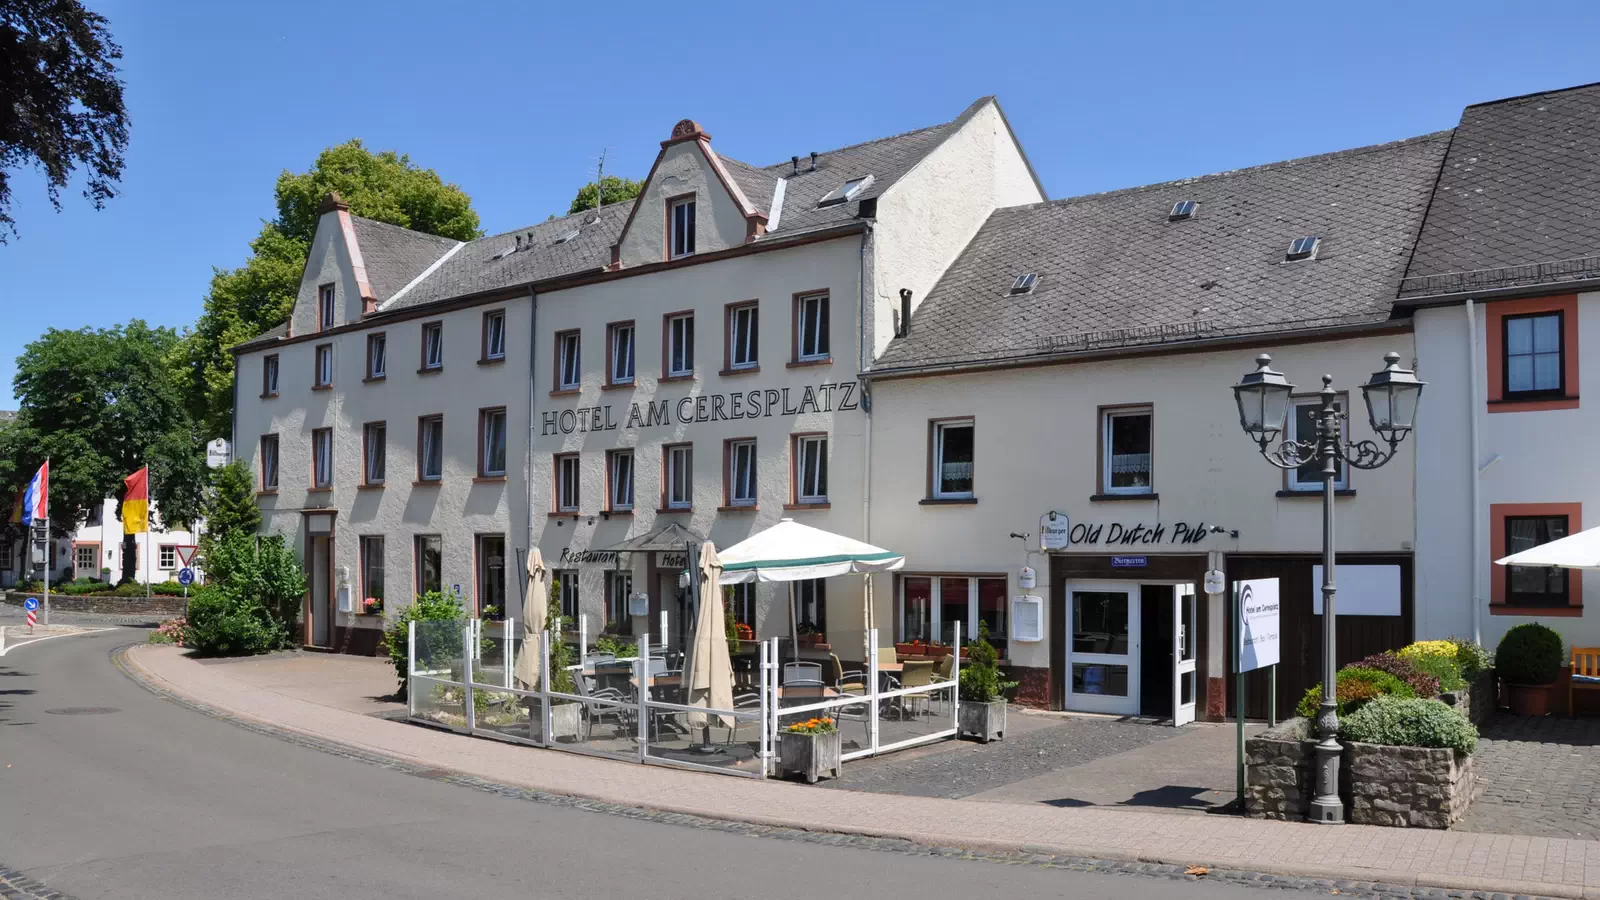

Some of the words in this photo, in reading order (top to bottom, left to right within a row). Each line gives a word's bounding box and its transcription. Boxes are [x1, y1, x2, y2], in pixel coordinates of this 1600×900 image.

[541, 405, 617, 436] HOTEL
[626, 399, 671, 429] AM
[676, 381, 859, 425] CERESPLATZ
[1069, 523, 1103, 544] Old
[1105, 522, 1165, 545] Dutch
[1171, 522, 1207, 544] Pub
[661, 553, 687, 566] Hote
